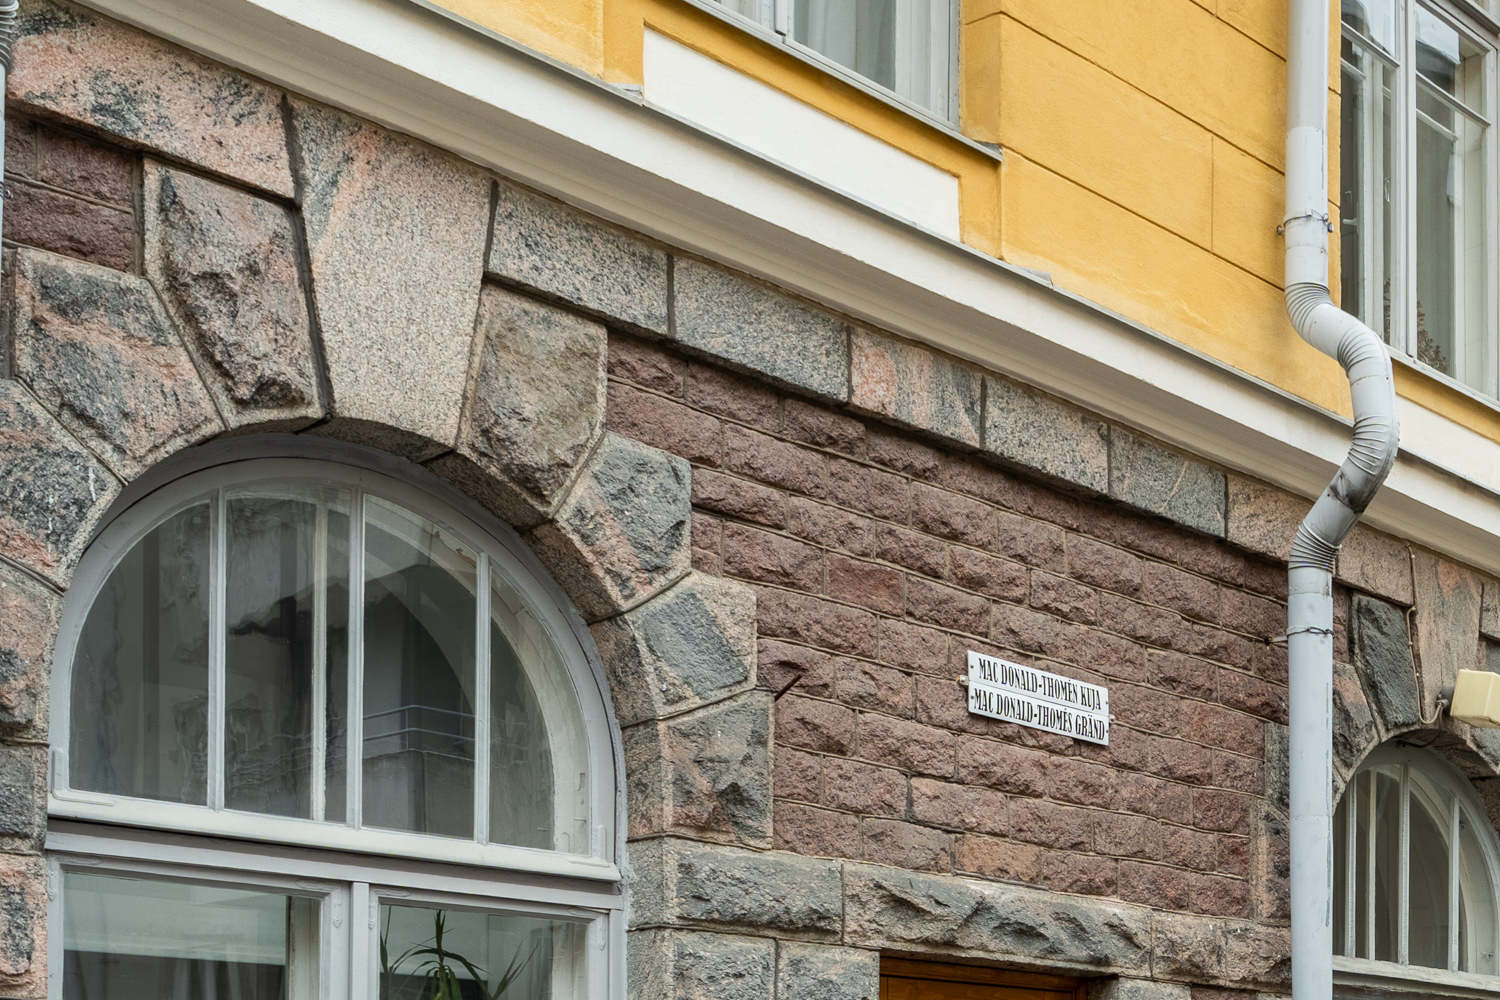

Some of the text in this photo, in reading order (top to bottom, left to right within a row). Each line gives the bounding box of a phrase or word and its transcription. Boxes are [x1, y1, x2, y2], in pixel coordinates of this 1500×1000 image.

[978, 658, 1101, 710] MAC DONALD-THOMÉN KUJA
[974, 688, 1105, 740] MAC DONALD-THOMÉS GRÄND
